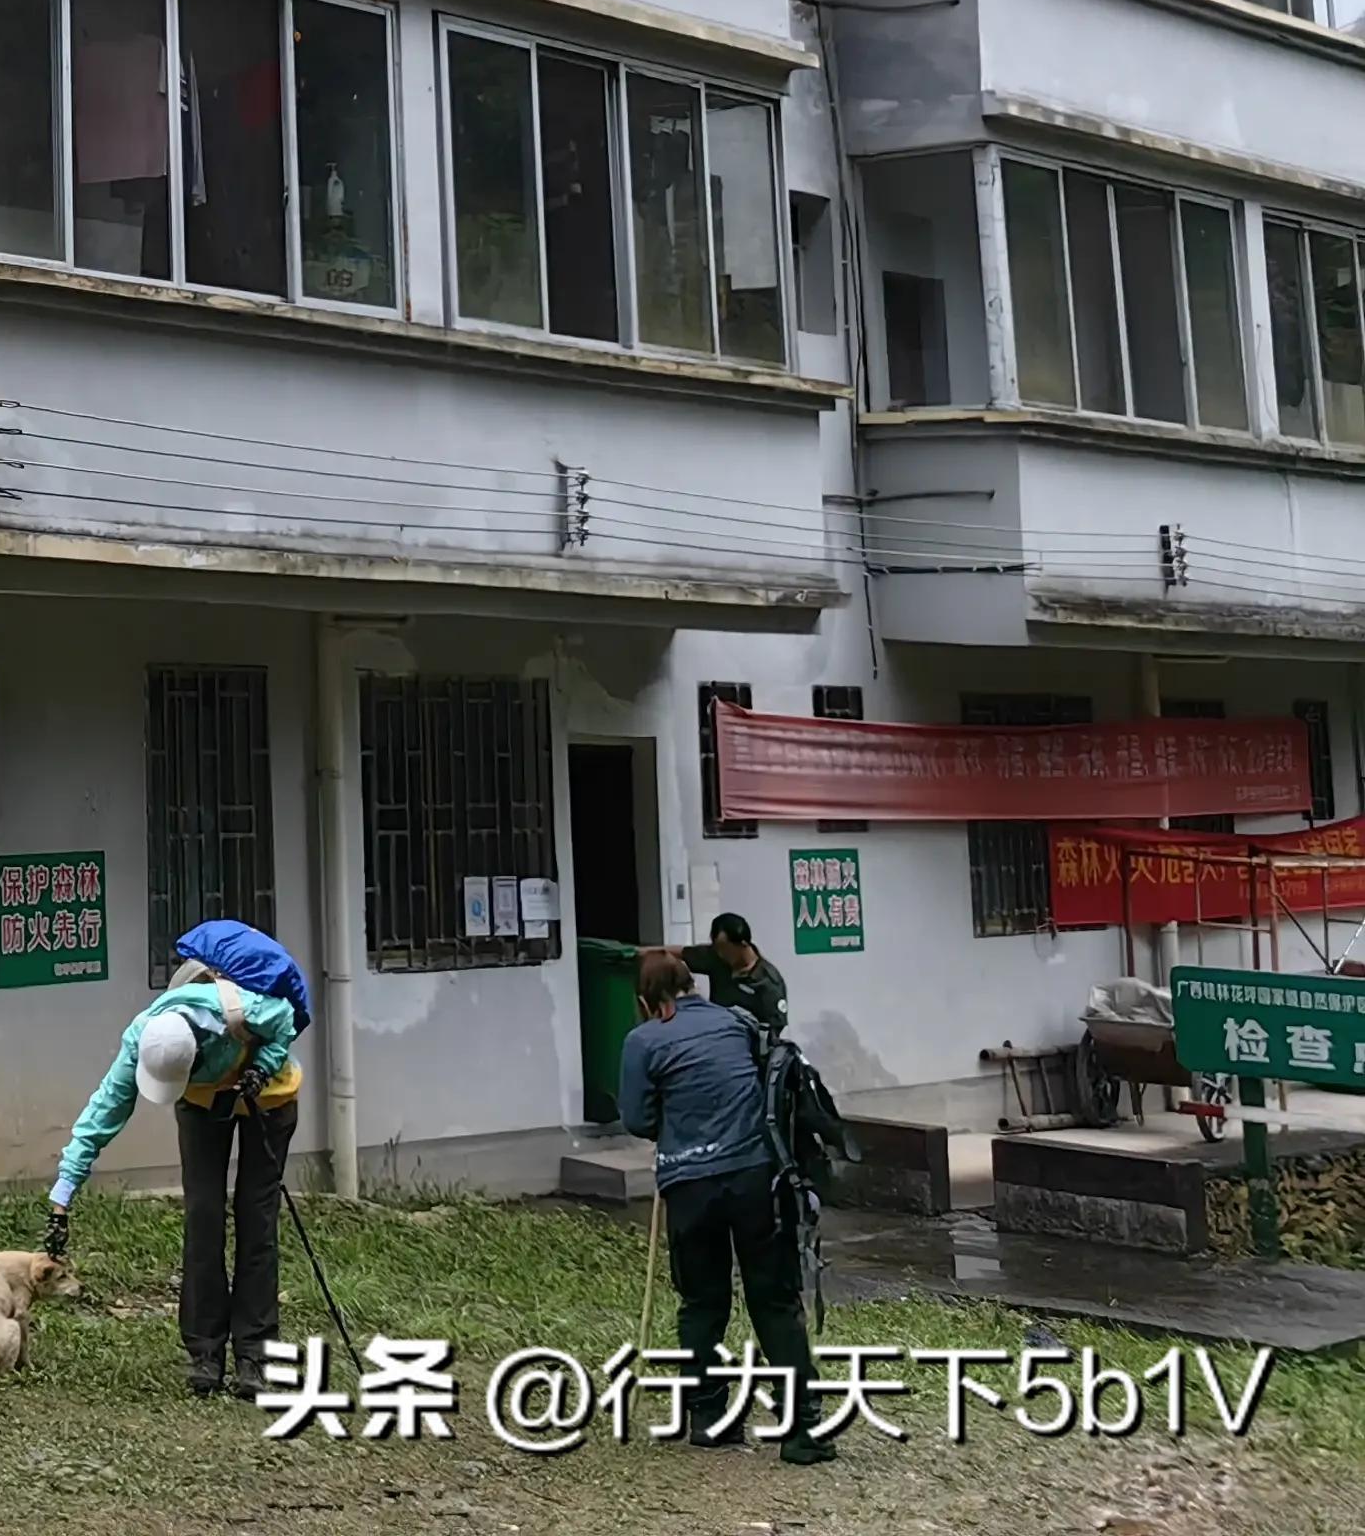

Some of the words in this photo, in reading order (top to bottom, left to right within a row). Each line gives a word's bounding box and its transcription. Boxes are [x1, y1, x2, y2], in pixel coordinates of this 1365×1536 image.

[0, 861, 101, 907] 保护森林
[0, 908, 102, 954] 防火先行
[796, 894, 860, 928] 人人有责
[1223, 1017, 1365, 1075] 检查
